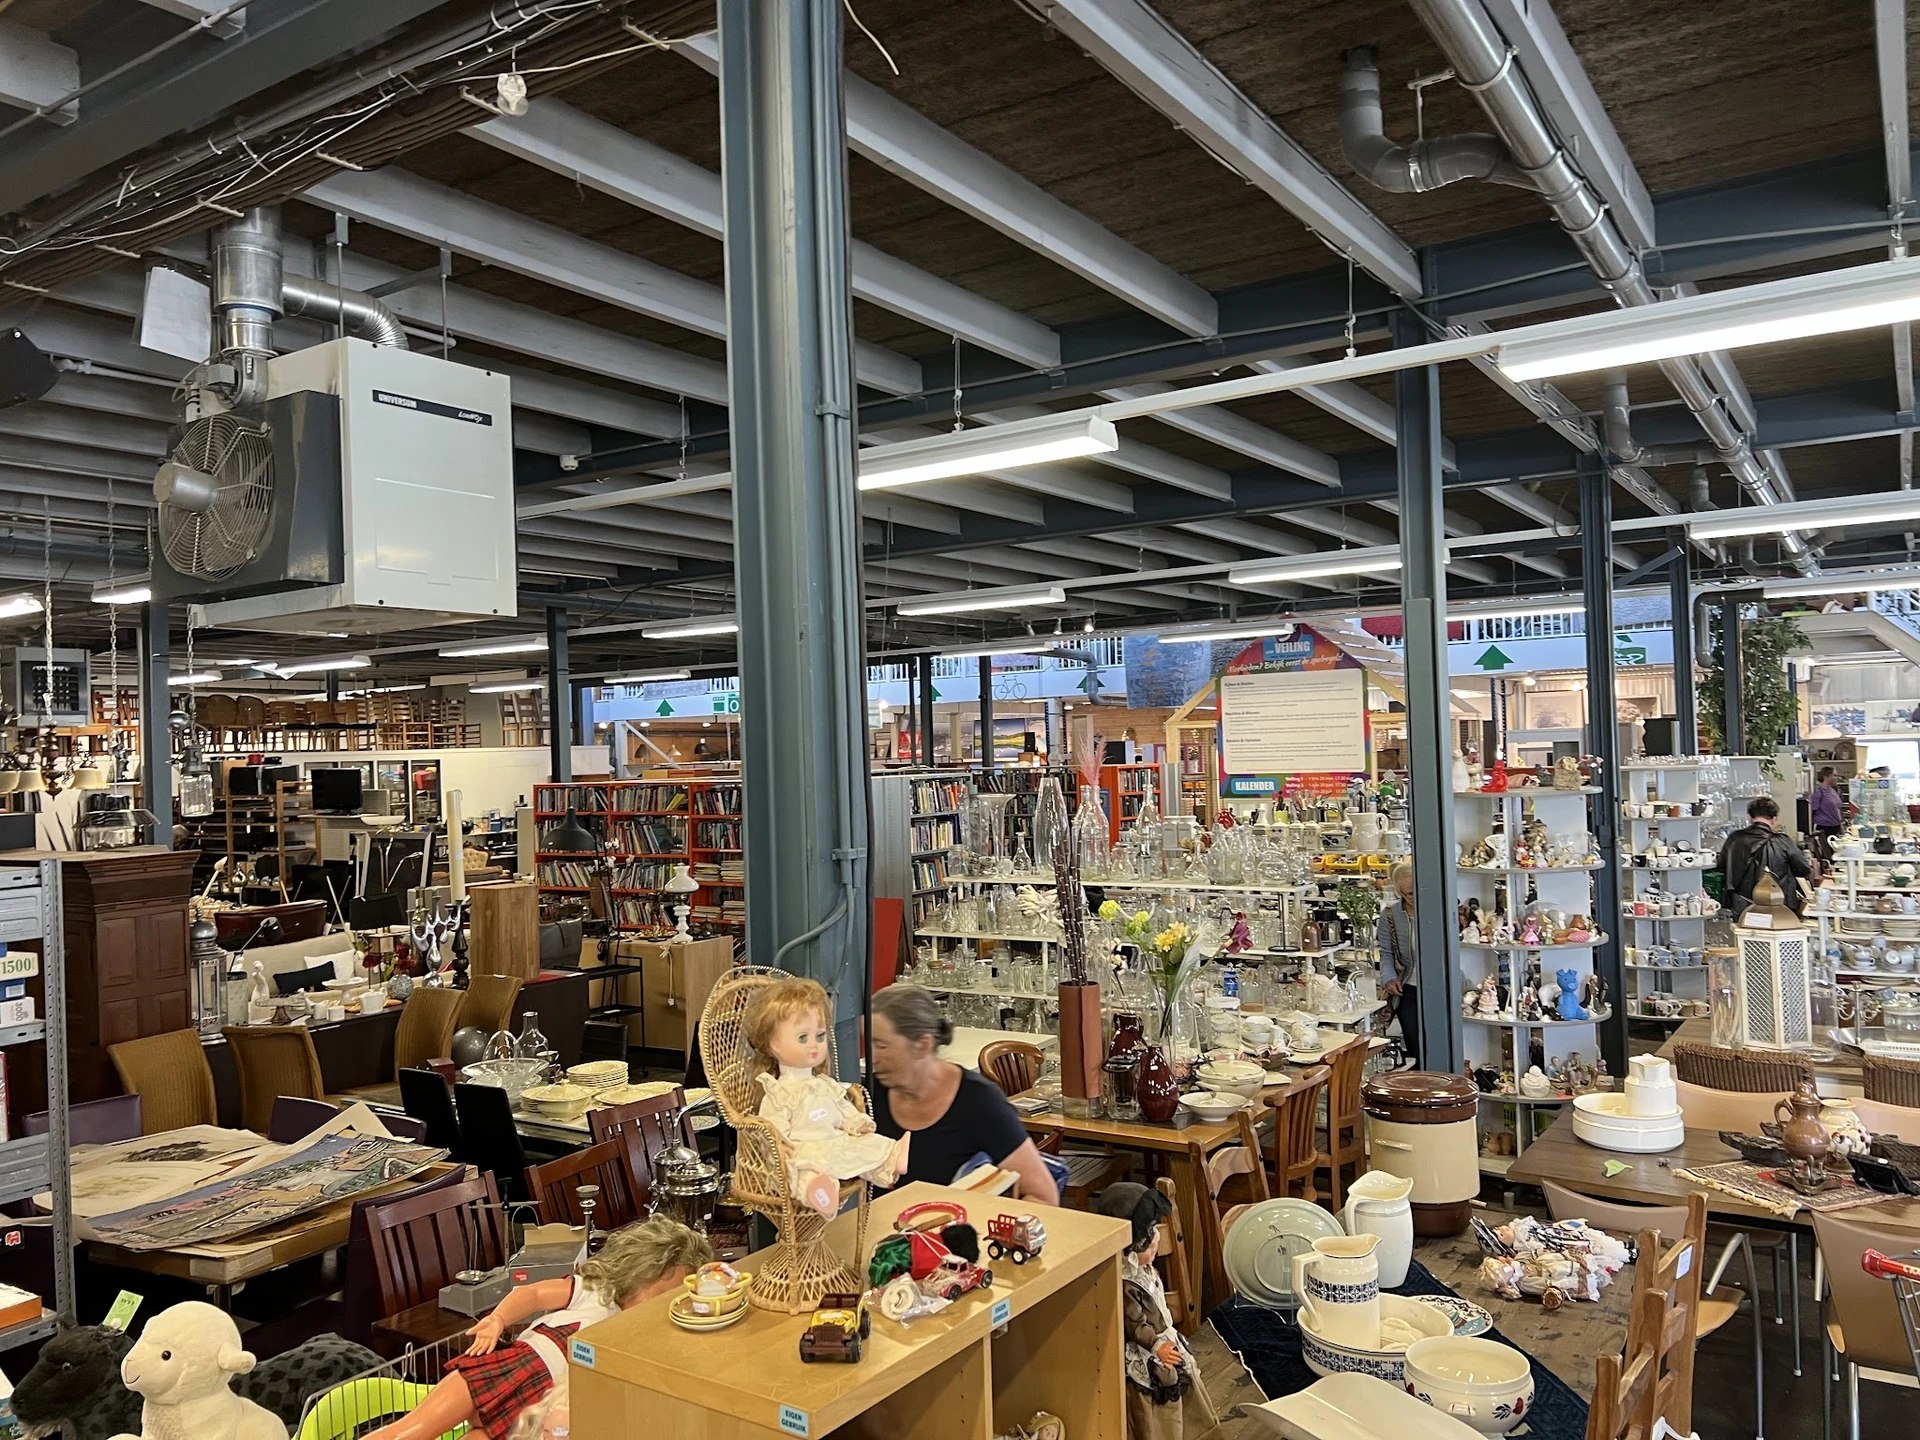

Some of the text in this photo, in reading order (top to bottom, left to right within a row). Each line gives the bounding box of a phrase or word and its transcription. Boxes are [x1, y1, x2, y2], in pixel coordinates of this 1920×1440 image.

[378, 393, 417, 408] UNIVERSUM
[1275, 641, 1311, 654] VEILING
[1235, 781, 1275, 791] KALENDER
[2, 958, 31, 974] 1500
[15, 1002, 23, 1021] 3000
[576, 1343, 590, 1354] EIGEN
[573, 1351, 593, 1364] GEBRUIK
[785, 1410, 802, 1421] EIGEN
[781, 1418, 807, 1434] GEBRUIK
